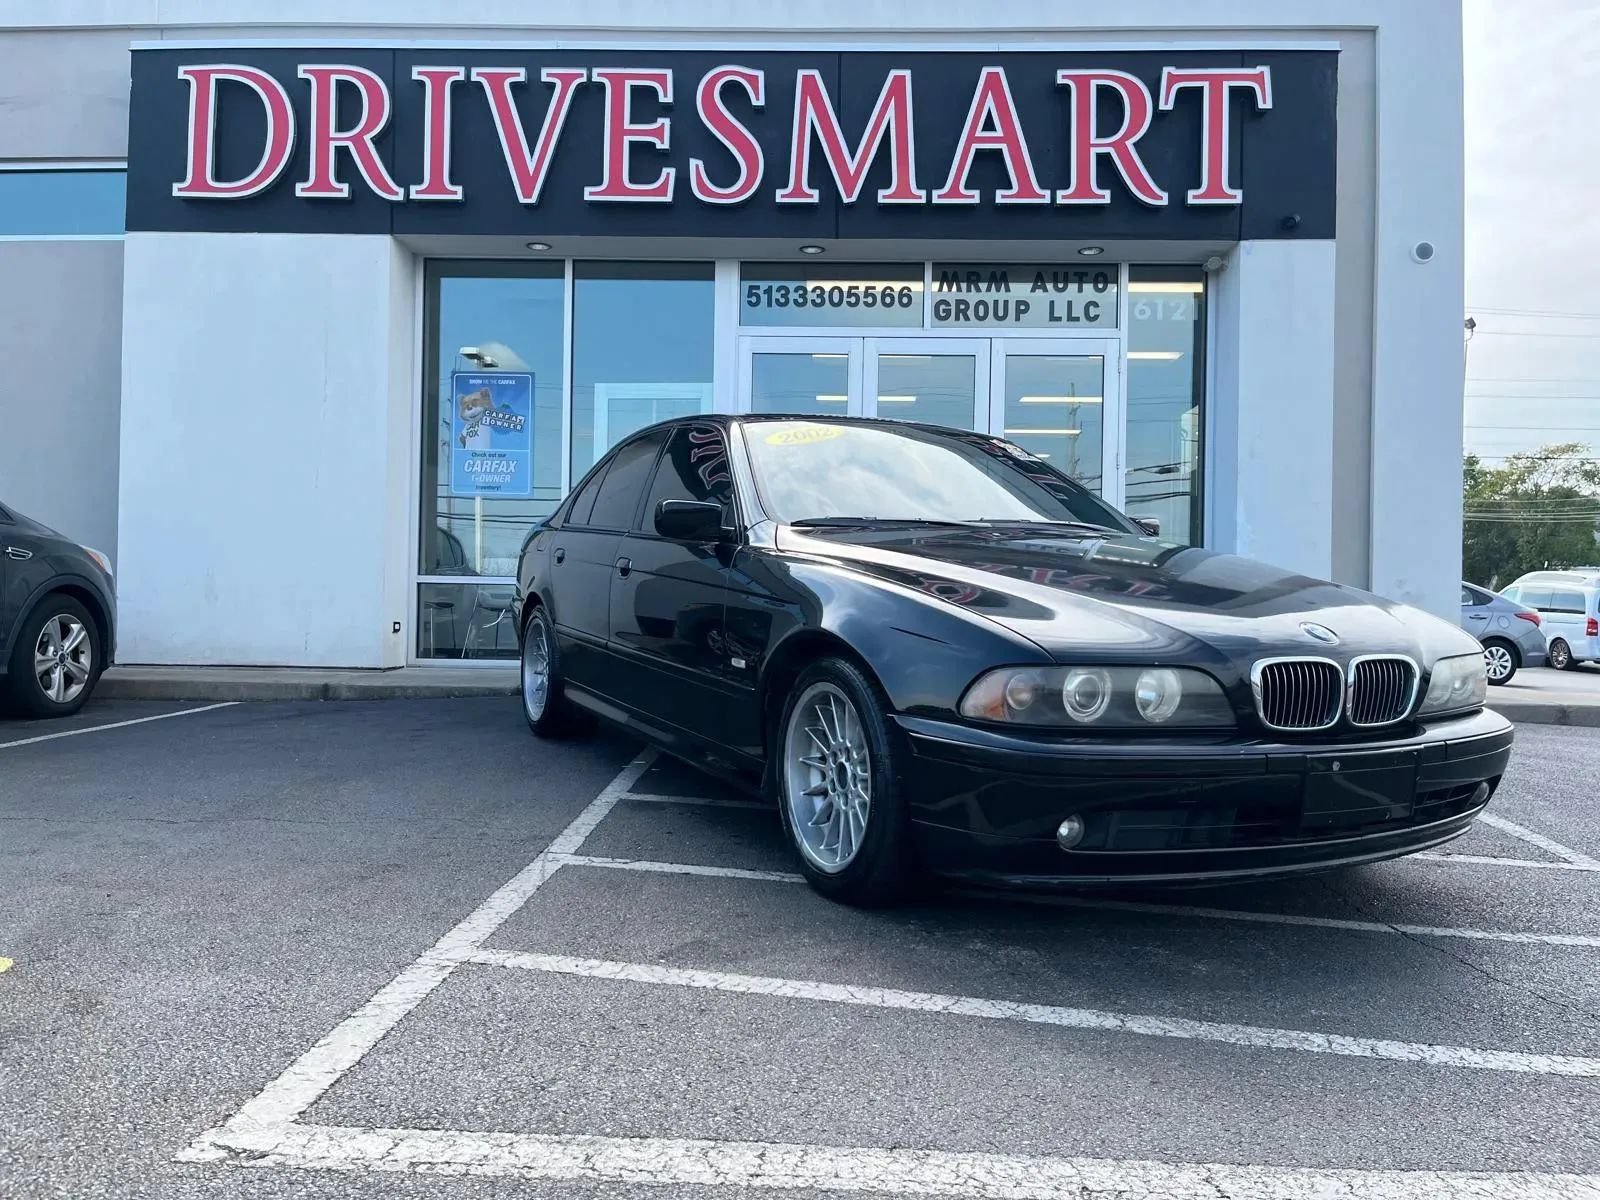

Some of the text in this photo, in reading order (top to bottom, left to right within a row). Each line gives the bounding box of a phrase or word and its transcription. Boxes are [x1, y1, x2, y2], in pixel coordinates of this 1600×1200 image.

[171, 63, 1274, 207] DRIVESMART
[937, 271, 1109, 293] MRM AUTO
[746, 285, 913, 309] 5133305566
[934, 299, 1101, 322] GROUP LLC
[490, 419, 522, 430] OWNER
[464, 460, 517, 472] CARFAX
